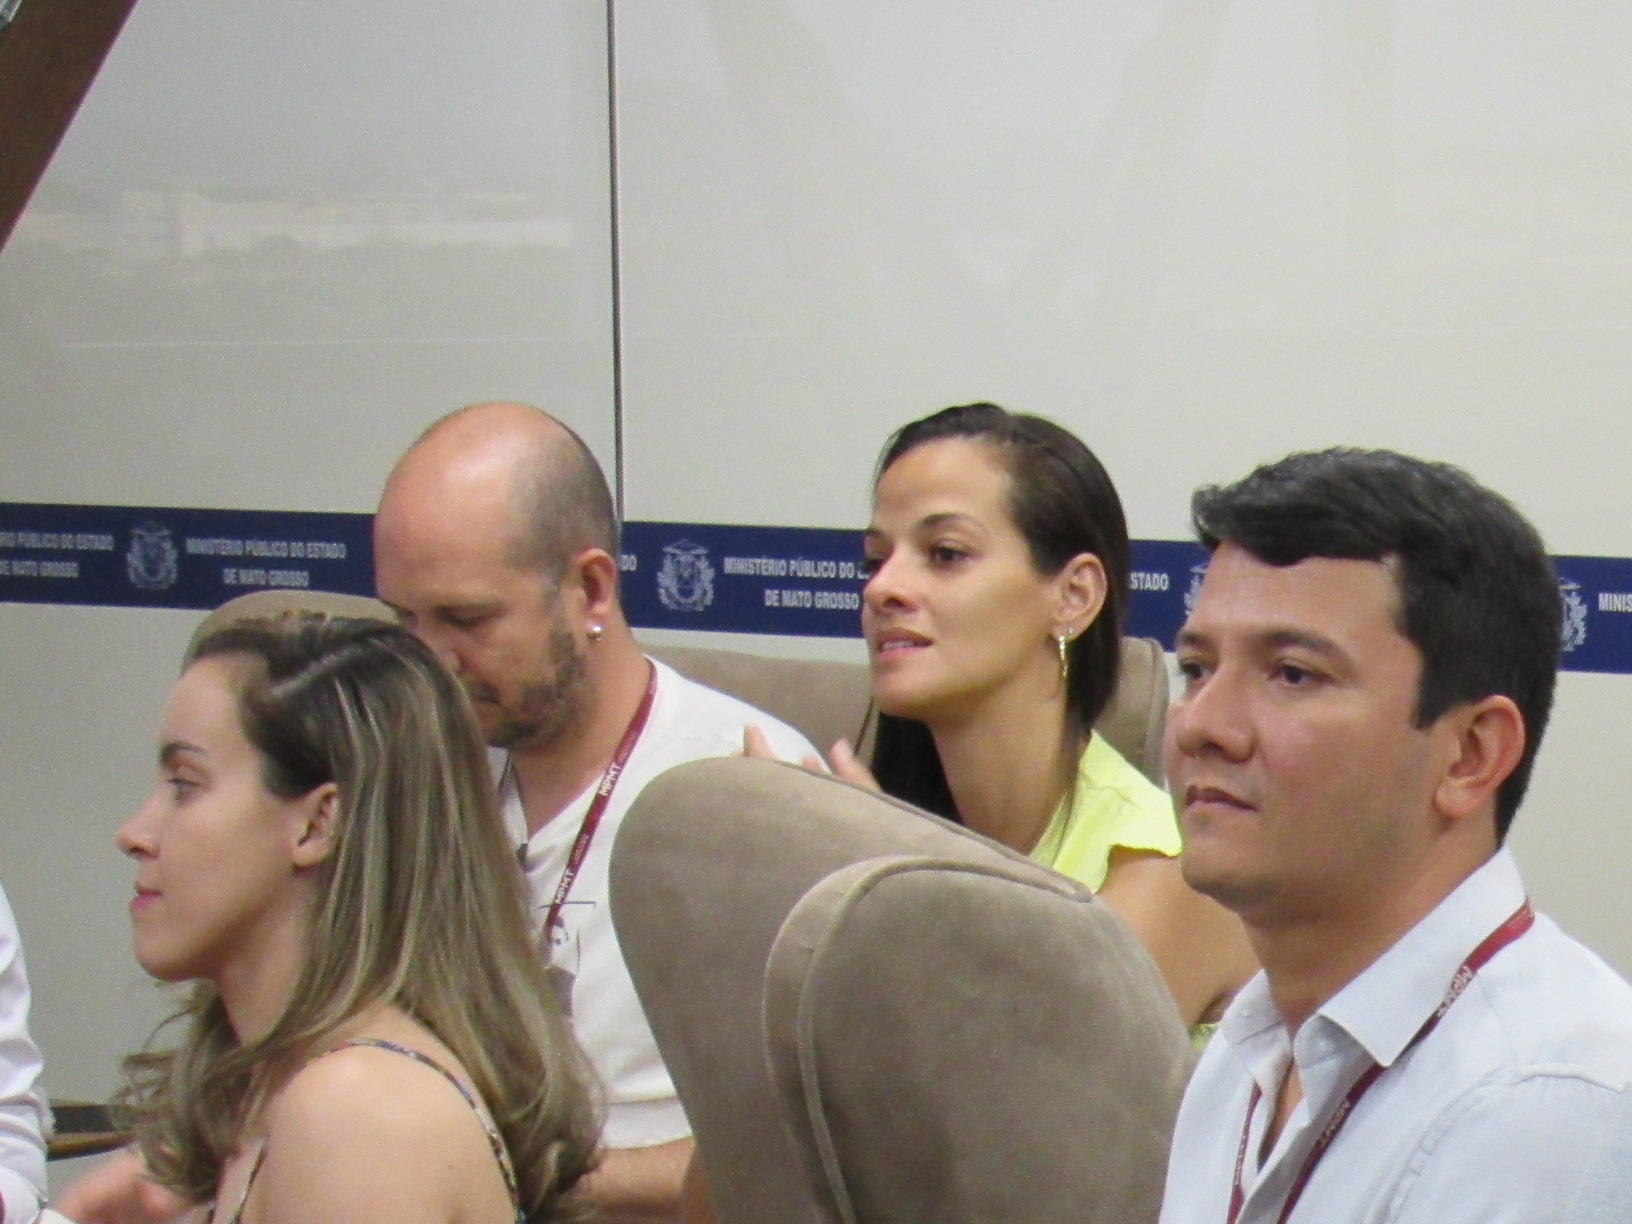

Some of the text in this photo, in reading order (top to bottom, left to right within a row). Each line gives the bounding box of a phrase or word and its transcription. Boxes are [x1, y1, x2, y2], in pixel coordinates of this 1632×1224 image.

[723, 555, 786, 576] MINISTÉRIO
[789, 556, 836, 579] PÚBLICO
[838, 561, 854, 579] DO
[1129, 571, 1169, 591] STADO
[764, 589, 860, 610] DE MATO GROSSO
[599, 761, 621, 796] MPMT
